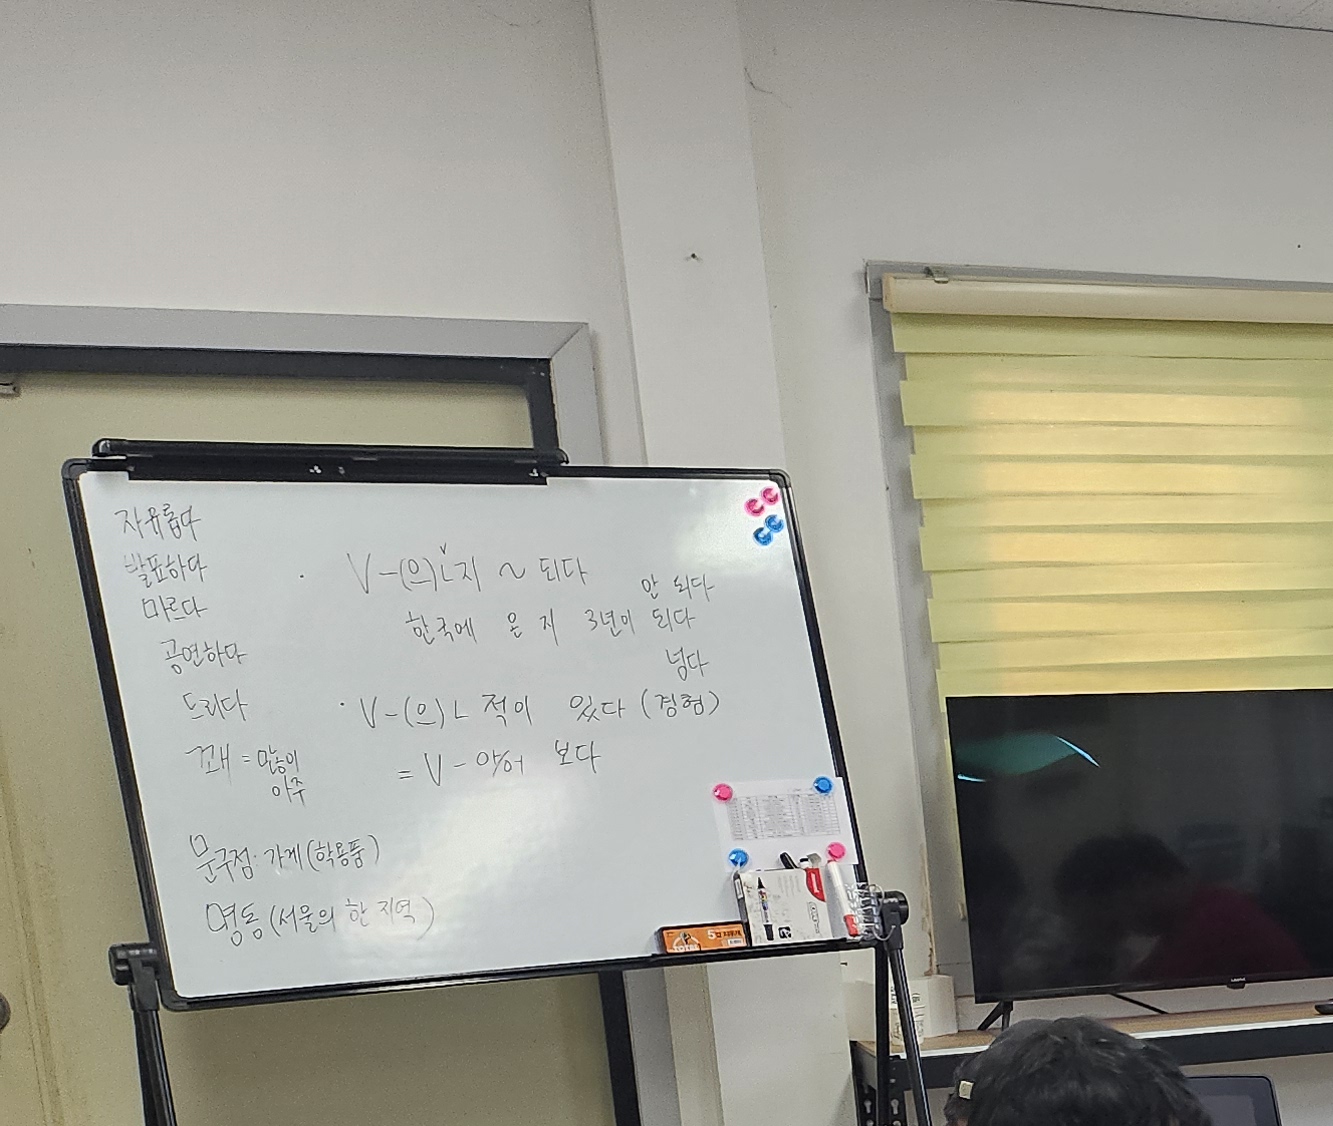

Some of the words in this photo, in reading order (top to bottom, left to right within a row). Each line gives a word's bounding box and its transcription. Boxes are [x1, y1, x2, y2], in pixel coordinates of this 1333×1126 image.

[124, 553, 208, 588] 발표하다
[539, 557, 588, 586] 되다
[641, 574, 659, 600] 안
[674, 574, 716, 602] 되다
[142, 595, 208, 622] 마르다
[405, 611, 478, 645] 한국에
[539, 608, 559, 646] 지
[652, 607, 697, 633] 되다
[183, 688, 248, 721] 드리다
[482, 694, 532, 727] 적이
[570, 695, 626, 722] 있다
[258, 744, 300, 775] 많이
[555, 739, 602, 774] 보다
[272, 775, 306, 806] 아주
[345, 898, 369, 927] 한
